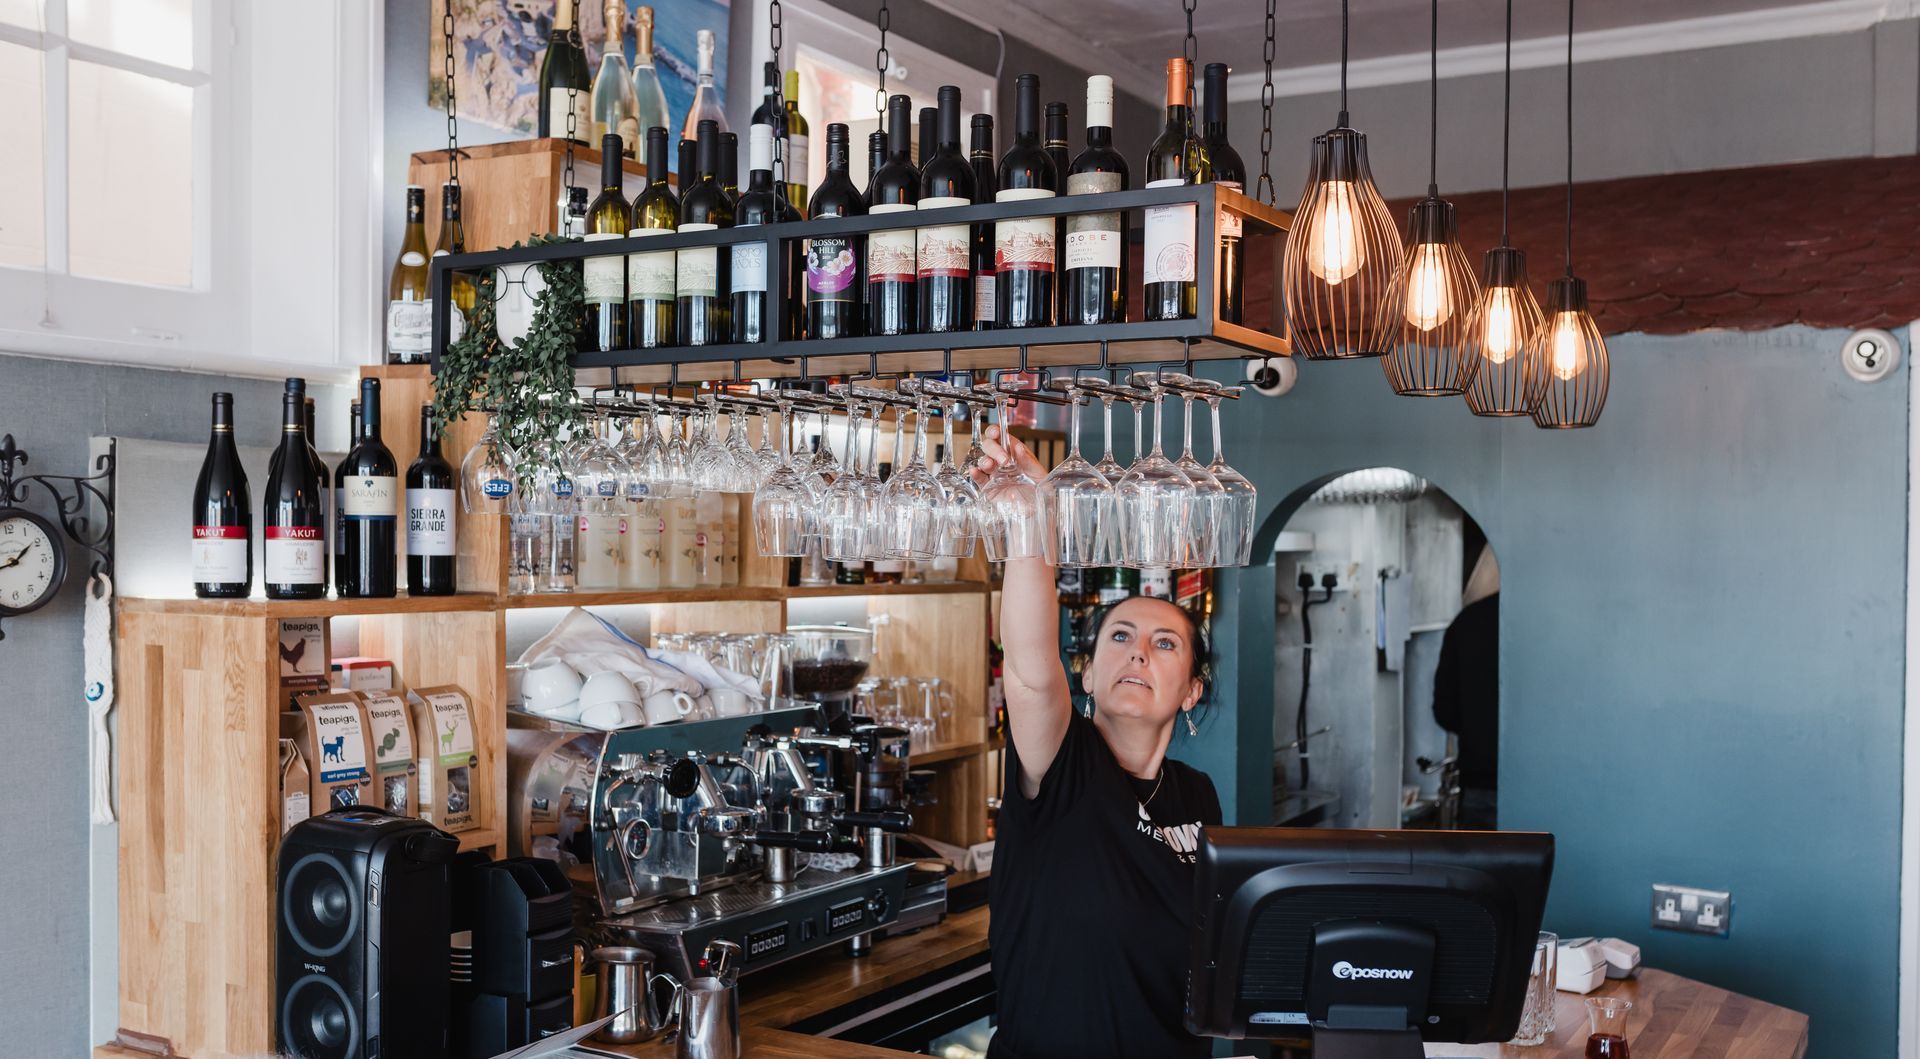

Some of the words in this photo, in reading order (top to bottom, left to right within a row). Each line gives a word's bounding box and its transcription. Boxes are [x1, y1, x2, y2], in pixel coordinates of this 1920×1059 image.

[812, 239, 846, 247] BLOSSOM
[1067, 234, 1107, 244] DOBE
[485, 483, 510, 493] EFES
[411, 508, 446, 519] SIERRA
[411, 520, 446, 532] GRANDE
[196, 528, 226, 537] YAKUT
[284, 529, 316, 538] YAKUT
